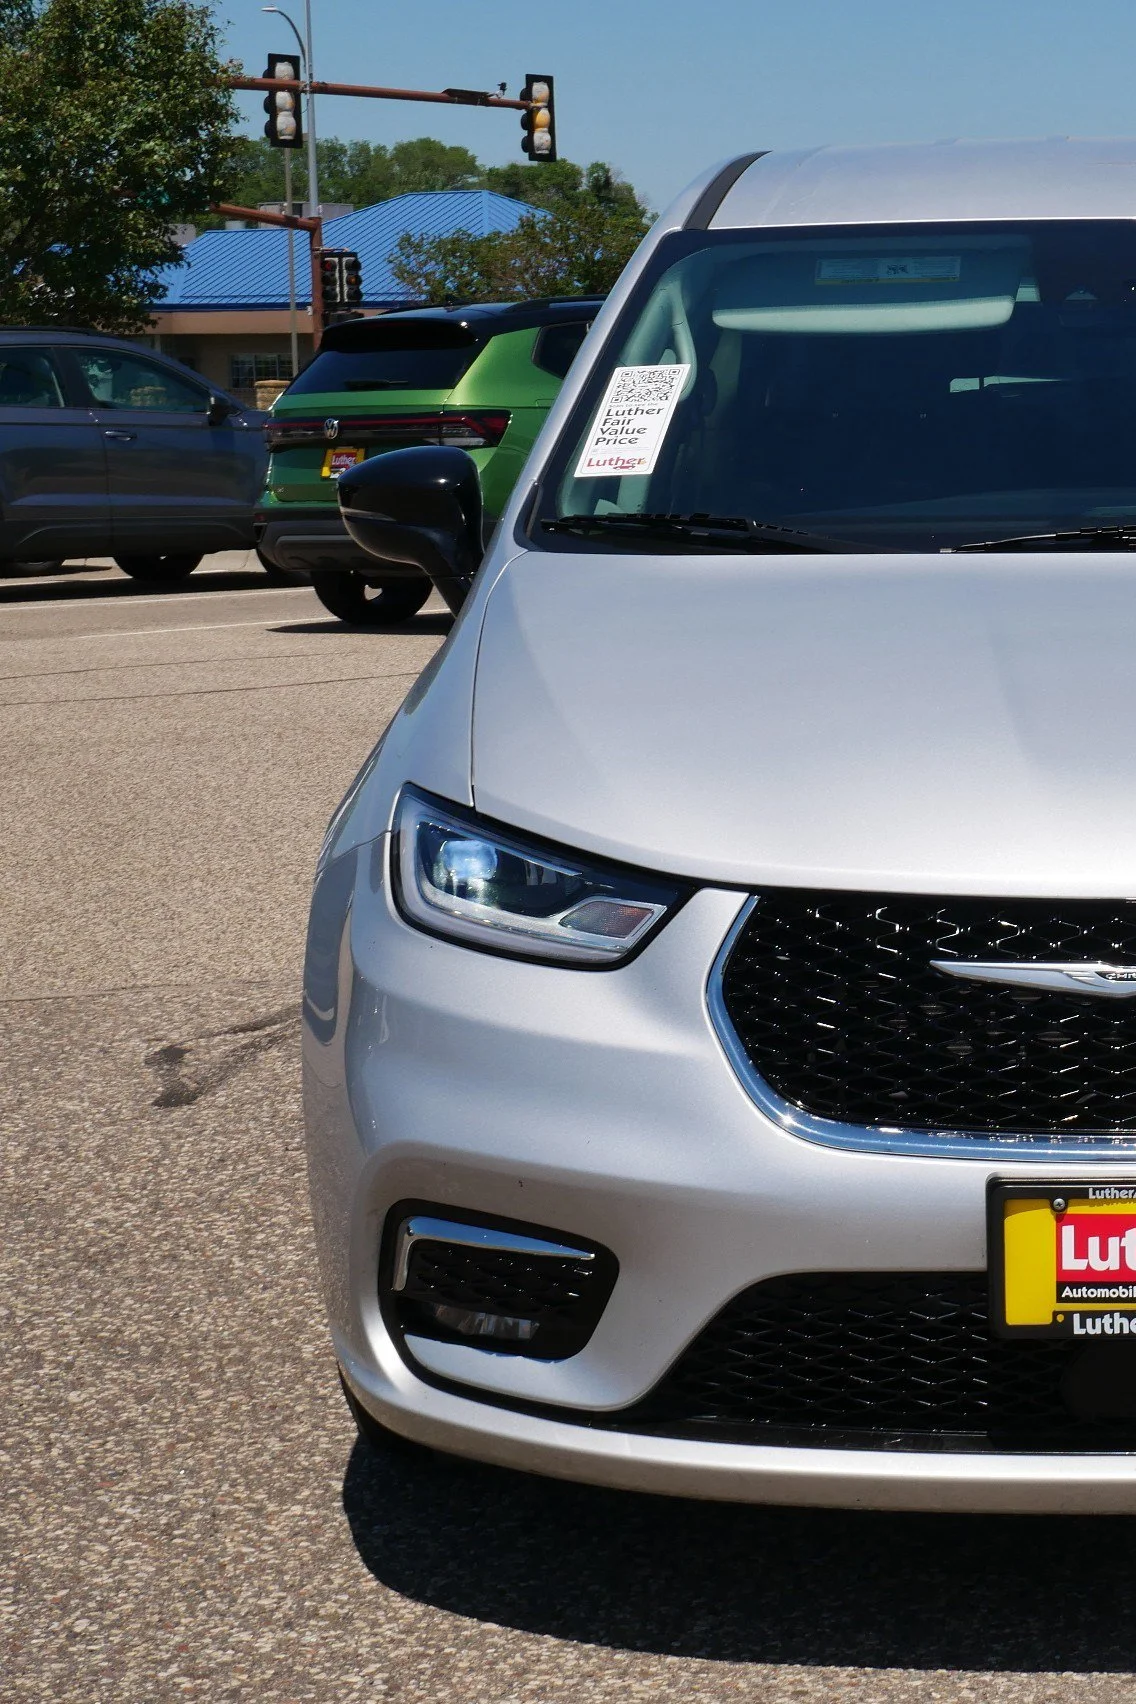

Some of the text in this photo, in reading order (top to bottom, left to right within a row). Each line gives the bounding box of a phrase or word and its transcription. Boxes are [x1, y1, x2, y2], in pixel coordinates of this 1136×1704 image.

[606, 407, 664, 417] Luther
[602, 417, 634, 426] Fair
[600, 426, 648, 436] Value
[595, 436, 639, 446] Price
[331, 454, 356, 465] Luther
[587, 456, 645, 467] Luther
